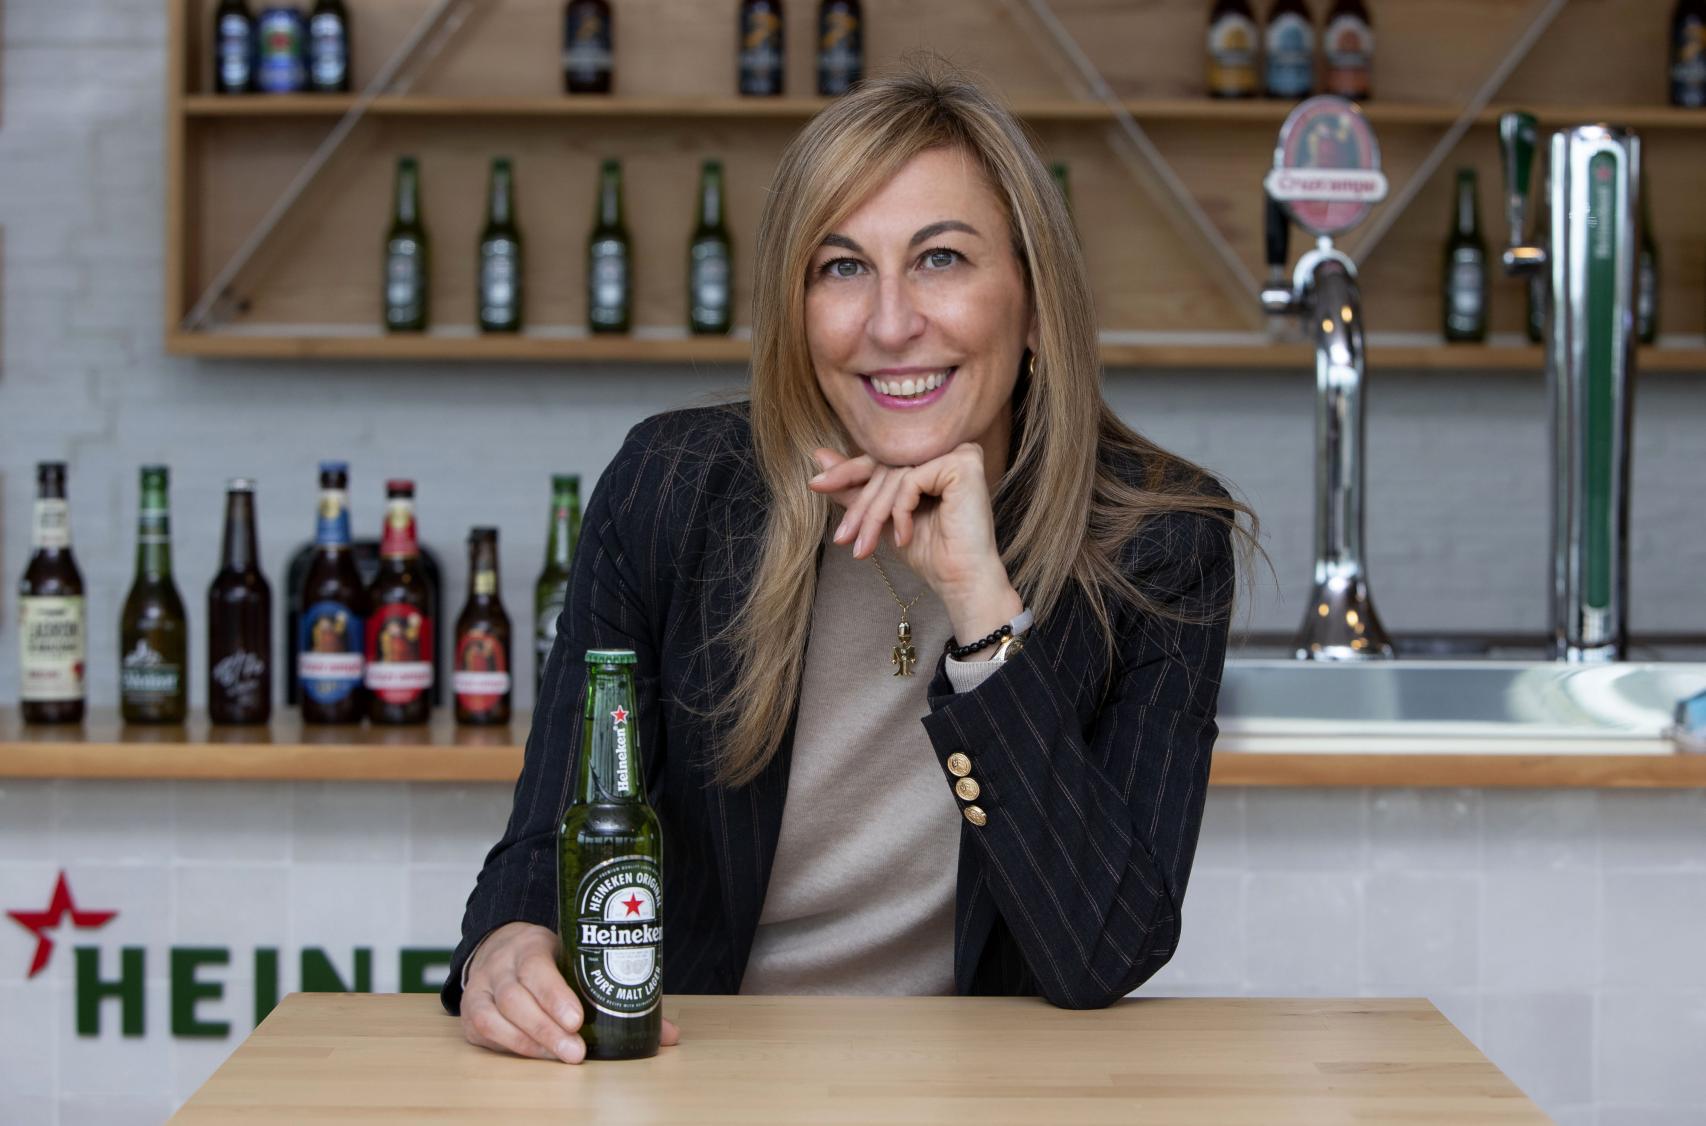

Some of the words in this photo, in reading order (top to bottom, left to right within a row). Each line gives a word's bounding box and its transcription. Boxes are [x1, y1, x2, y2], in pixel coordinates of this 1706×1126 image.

[616, 728, 629, 791] Heineken
[588, 872, 633, 911] HEINEKEN
[636, 872, 662, 909] ORIGINAL
[590, 968, 615, 996] PURE
[616, 987, 643, 1001] MALT
[644, 965, 661, 996] LAGER
